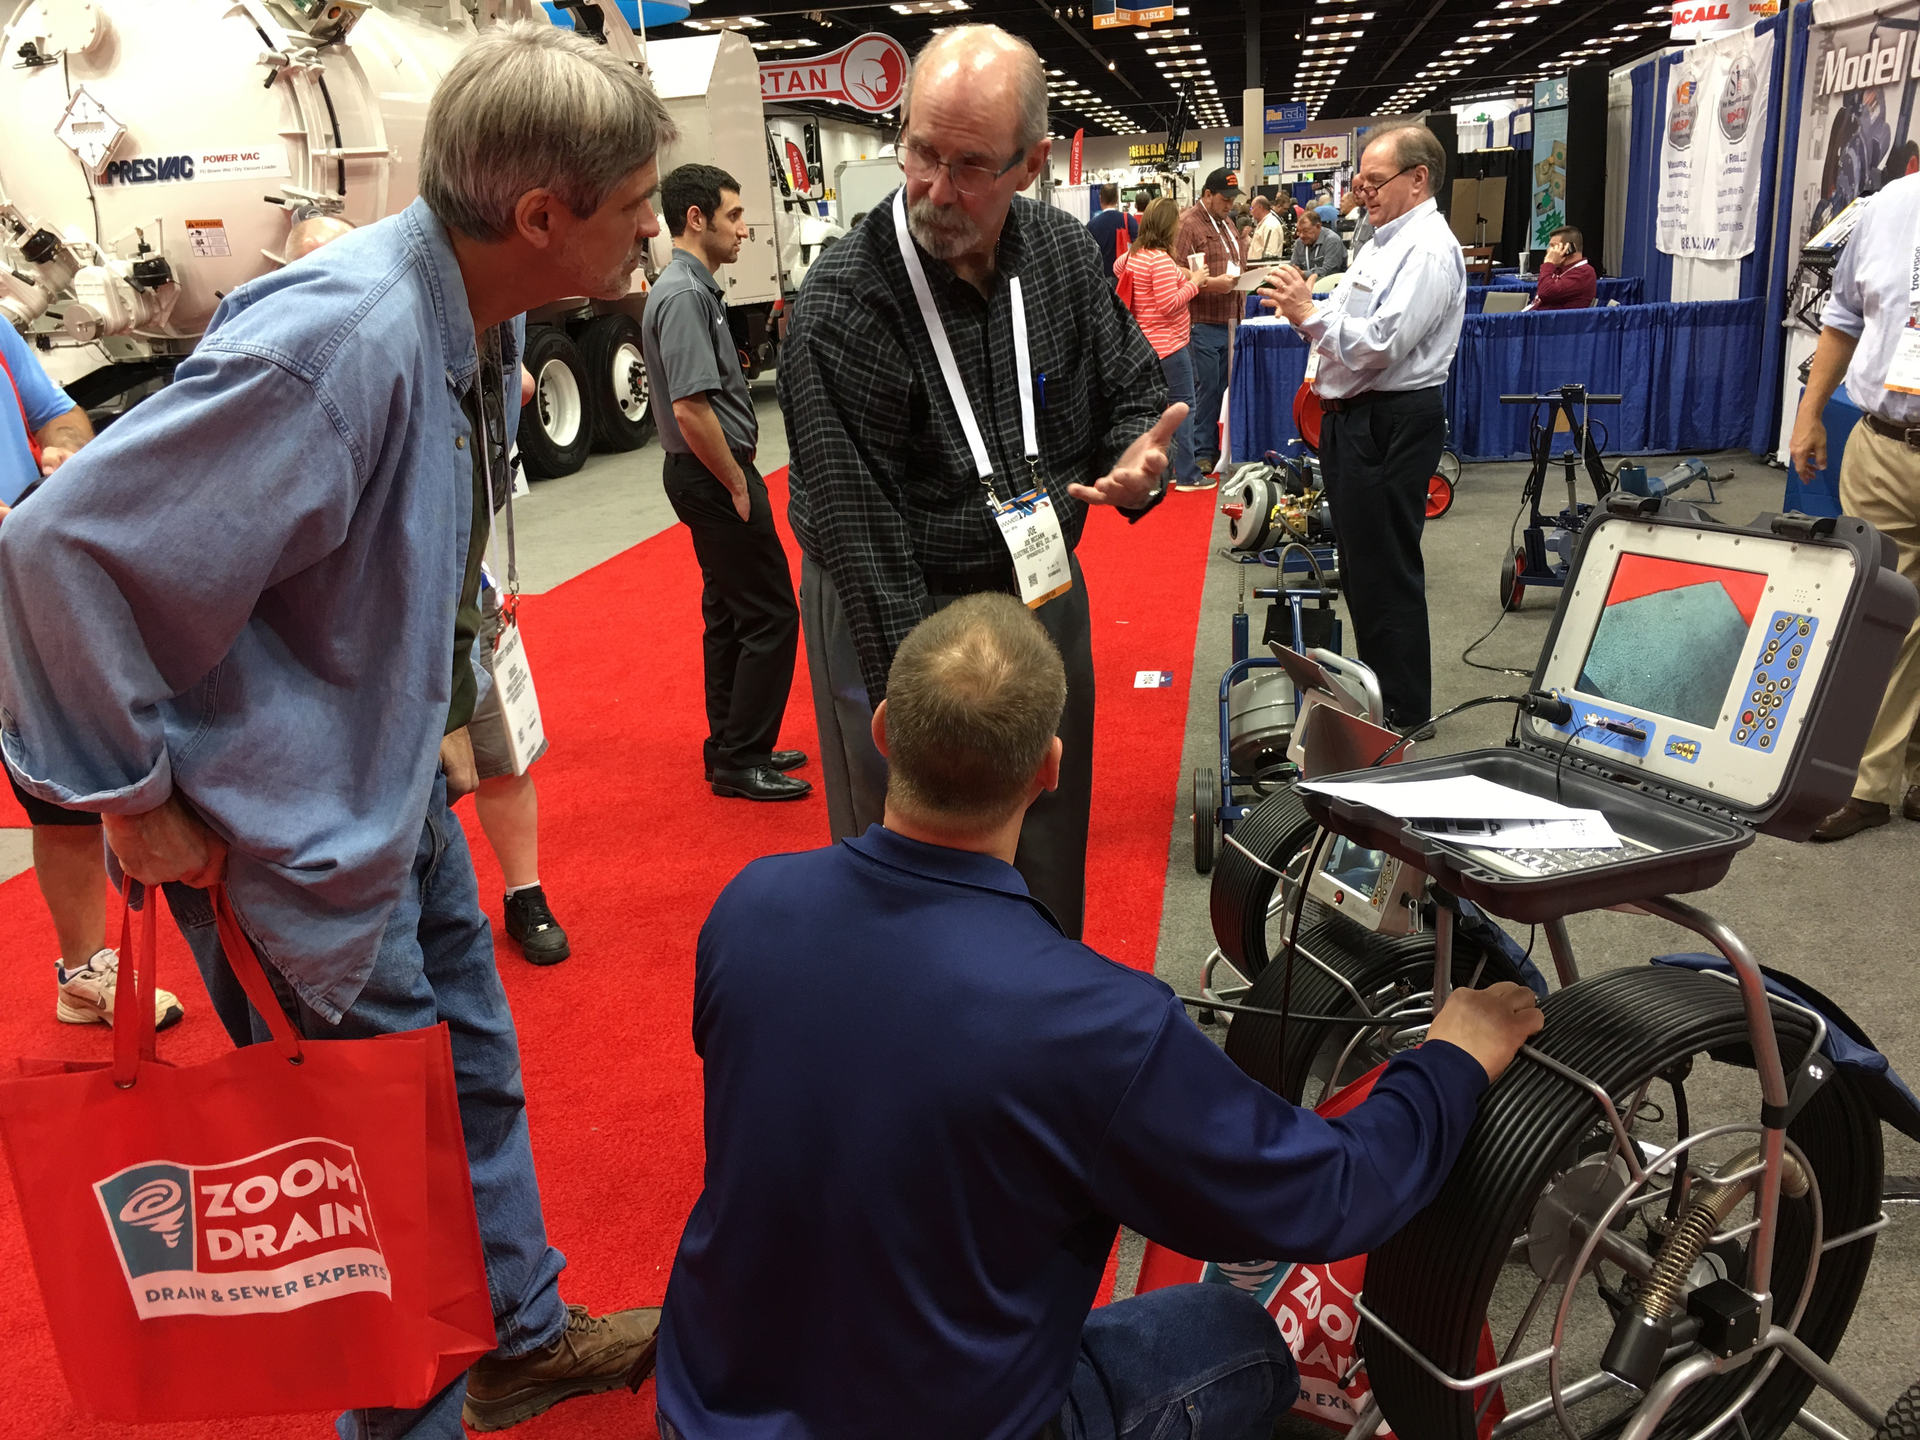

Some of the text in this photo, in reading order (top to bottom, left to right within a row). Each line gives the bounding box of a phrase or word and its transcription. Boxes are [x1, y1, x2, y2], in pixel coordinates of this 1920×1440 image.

[1100, 16, 1120, 26] AIS
[1140, 10, 1165, 20] AISLE
[1819, 31, 1909, 96] Model
[203, 152, 260, 164] POWER VAC
[1294, 143, 1338, 159] ProVac
[107, 155, 195, 184] PRESVAC
[1027, 526, 1037, 537] JOE
[200, 1156, 359, 1218] ZOOM
[205, 1202, 368, 1262] DRAIN
[145, 1263, 388, 1304] DRAIN & SEWER EXPERTS
[1290, 1266, 1361, 1346] ZOO
